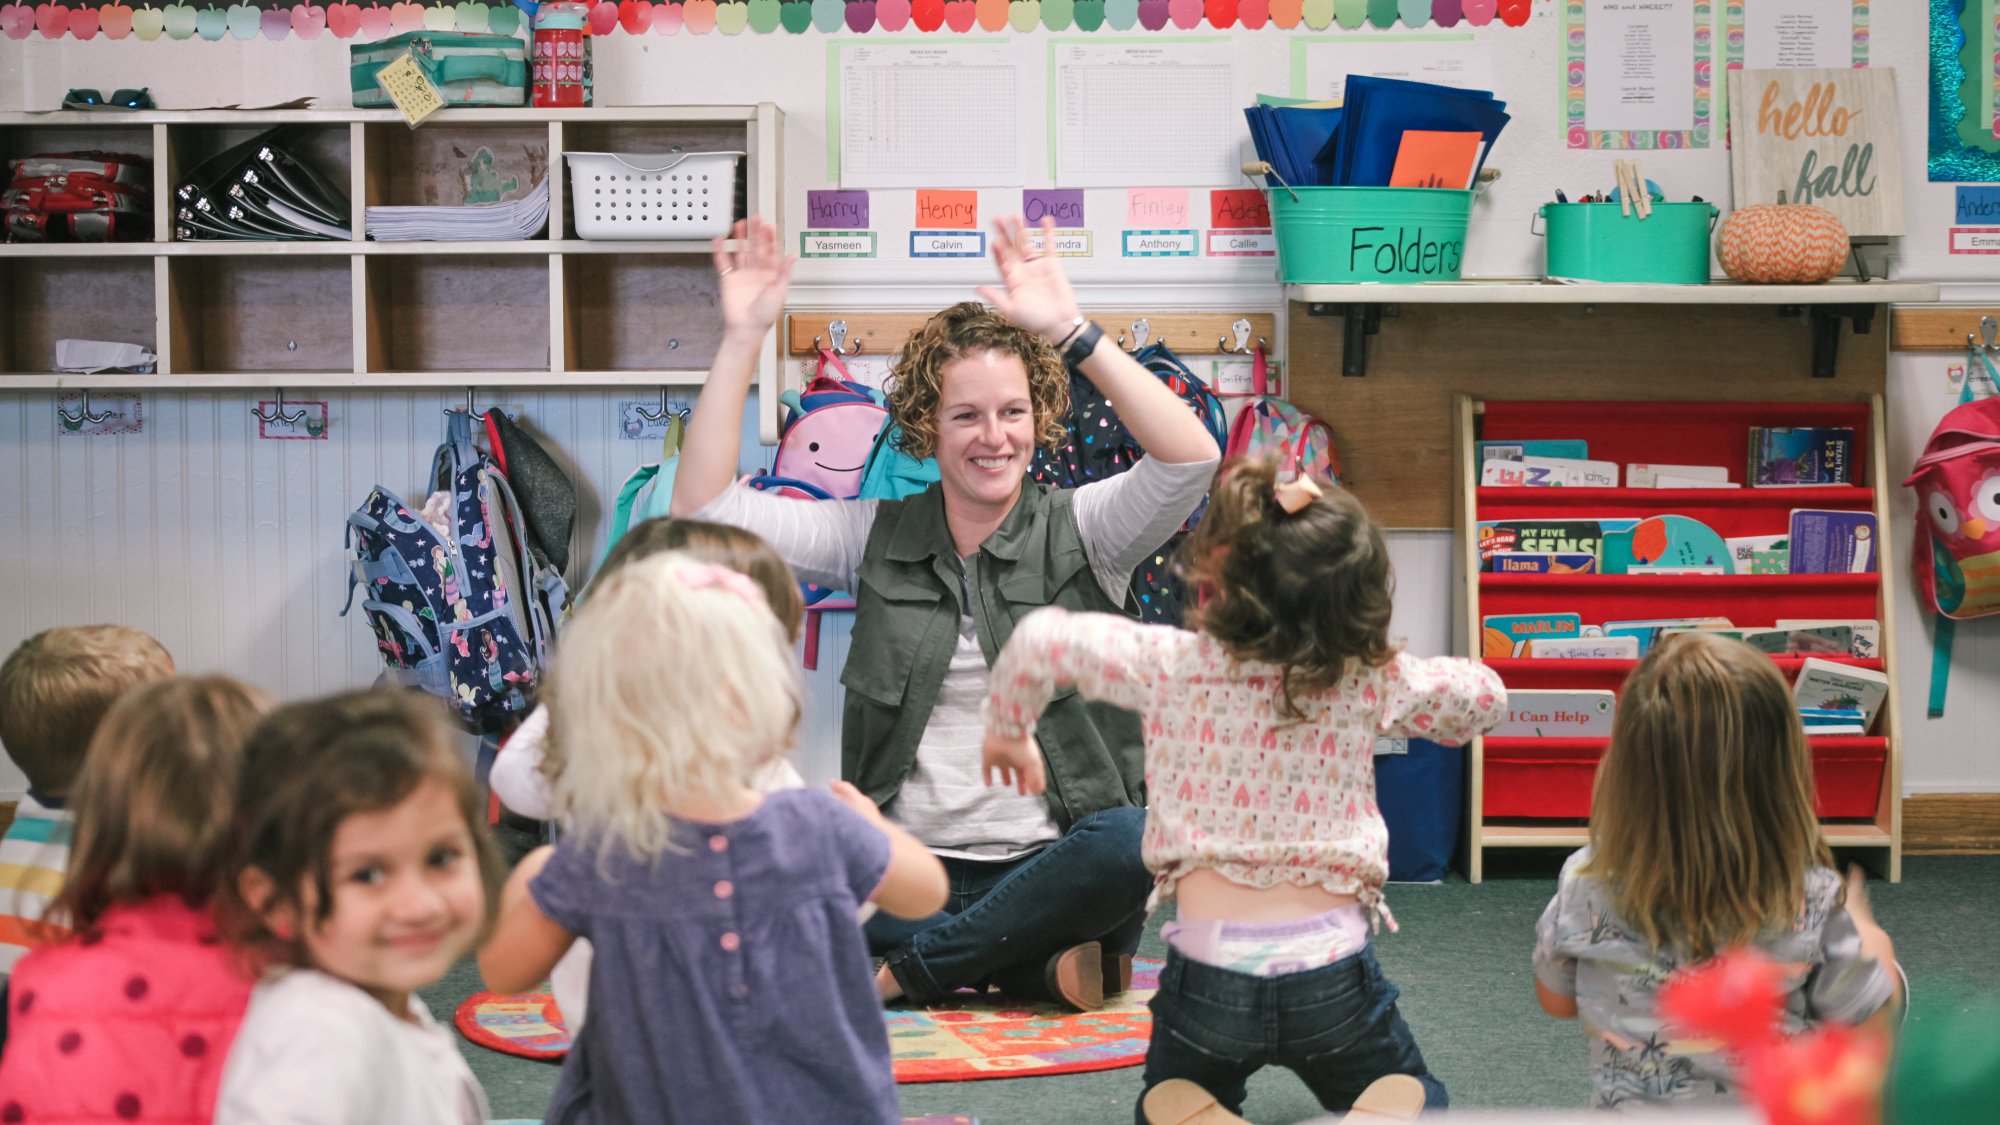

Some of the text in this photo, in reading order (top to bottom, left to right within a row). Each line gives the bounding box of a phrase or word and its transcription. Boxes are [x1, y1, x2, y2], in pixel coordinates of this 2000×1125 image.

[1757, 80, 1863, 141] hello
[1793, 142, 1877, 205] fall
[810, 195, 860, 226] Harry
[920, 195, 973, 224] Henry
[1025, 197, 1082, 221] Owen
[1131, 193, 1185, 225] Finley
[815, 240, 862, 251] Yasmeen
[931, 240, 963, 250] Calvin
[1028, 239, 1081, 249] asandra
[1139, 239, 1181, 250] Anthony
[1229, 239, 1258, 249] Callie
[1350, 226, 1461, 274] Folders
[1836, 440, 1844, 465] STEAM
[1521, 529, 1567, 538] MY FIVE
[1479, 539, 1496, 548] LET'S
[1502, 558, 1539, 571] llama
[1511, 619, 1575, 634] MARLIN
[1567, 649, 1589, 659] Time
[1509, 711, 1590, 725] I Can Help
